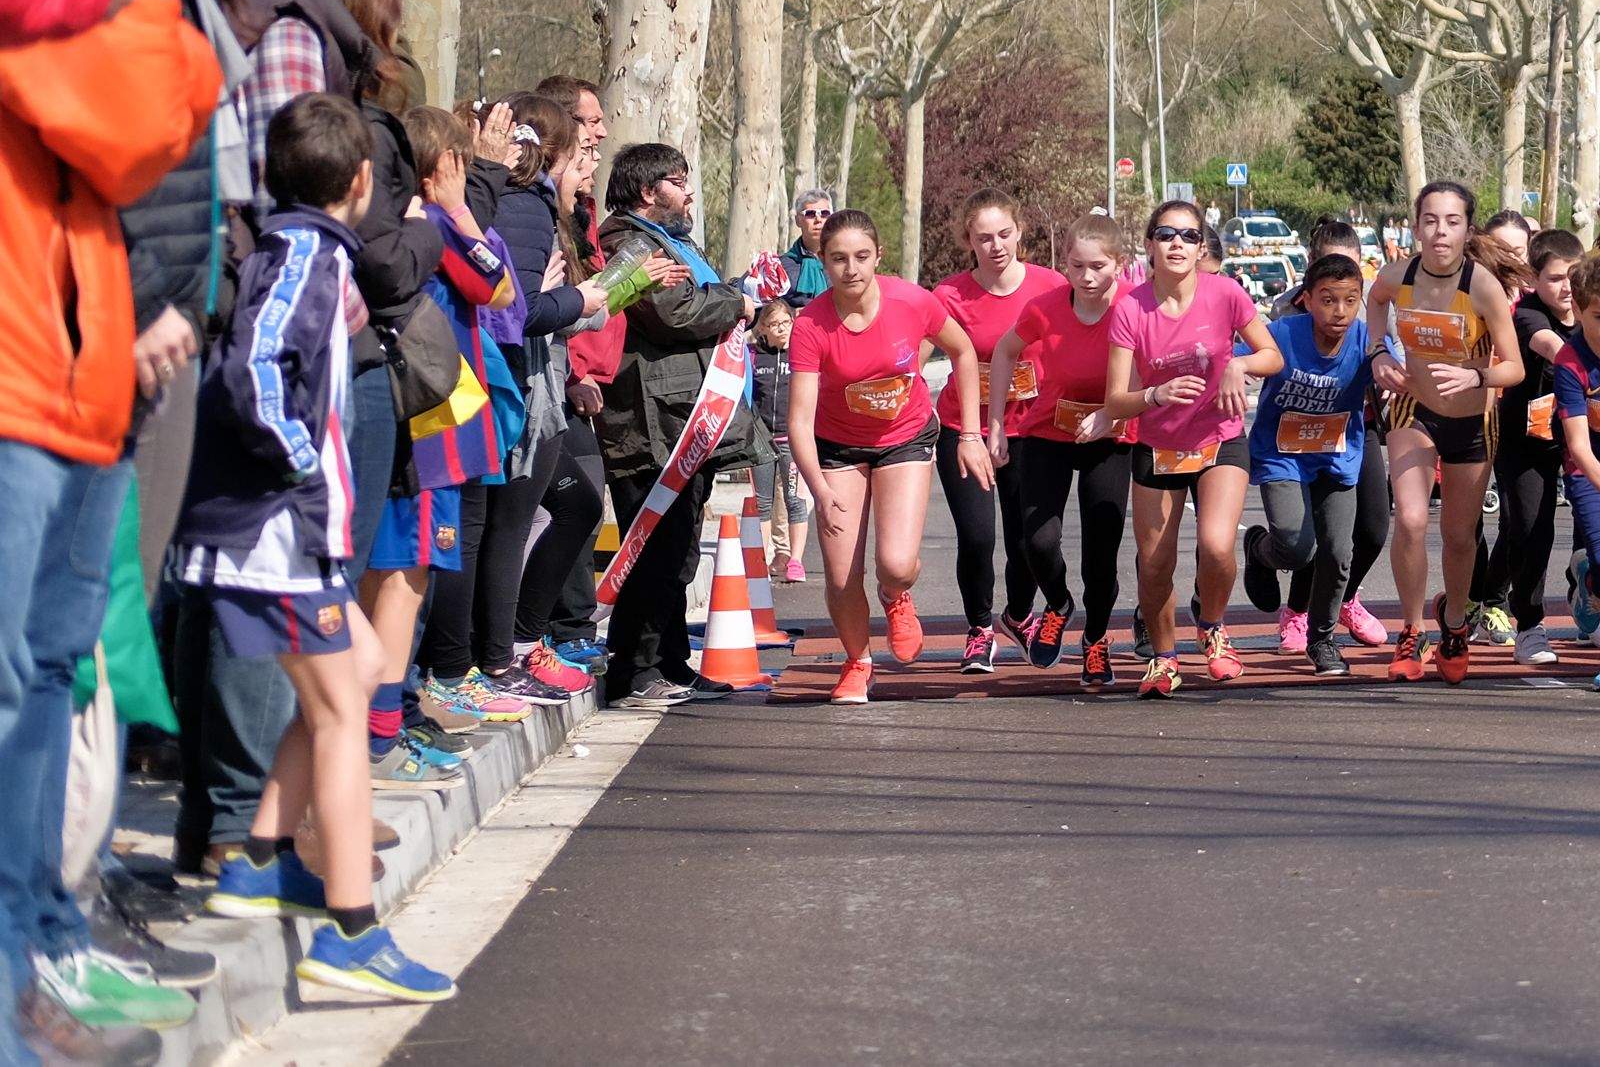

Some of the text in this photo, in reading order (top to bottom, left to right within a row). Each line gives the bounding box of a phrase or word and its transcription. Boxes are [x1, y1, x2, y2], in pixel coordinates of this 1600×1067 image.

[1413, 326, 1443, 338] ABRIL
[1417, 336, 1444, 348] 510
[1291, 368, 1338, 388] INSTITUT
[1280, 380, 1342, 401] ARNAU
[870, 398, 897, 410] 524
[1274, 394, 1334, 413] CADELL
[1300, 422, 1326, 430] ALEX
[1298, 428, 1325, 440] 537
